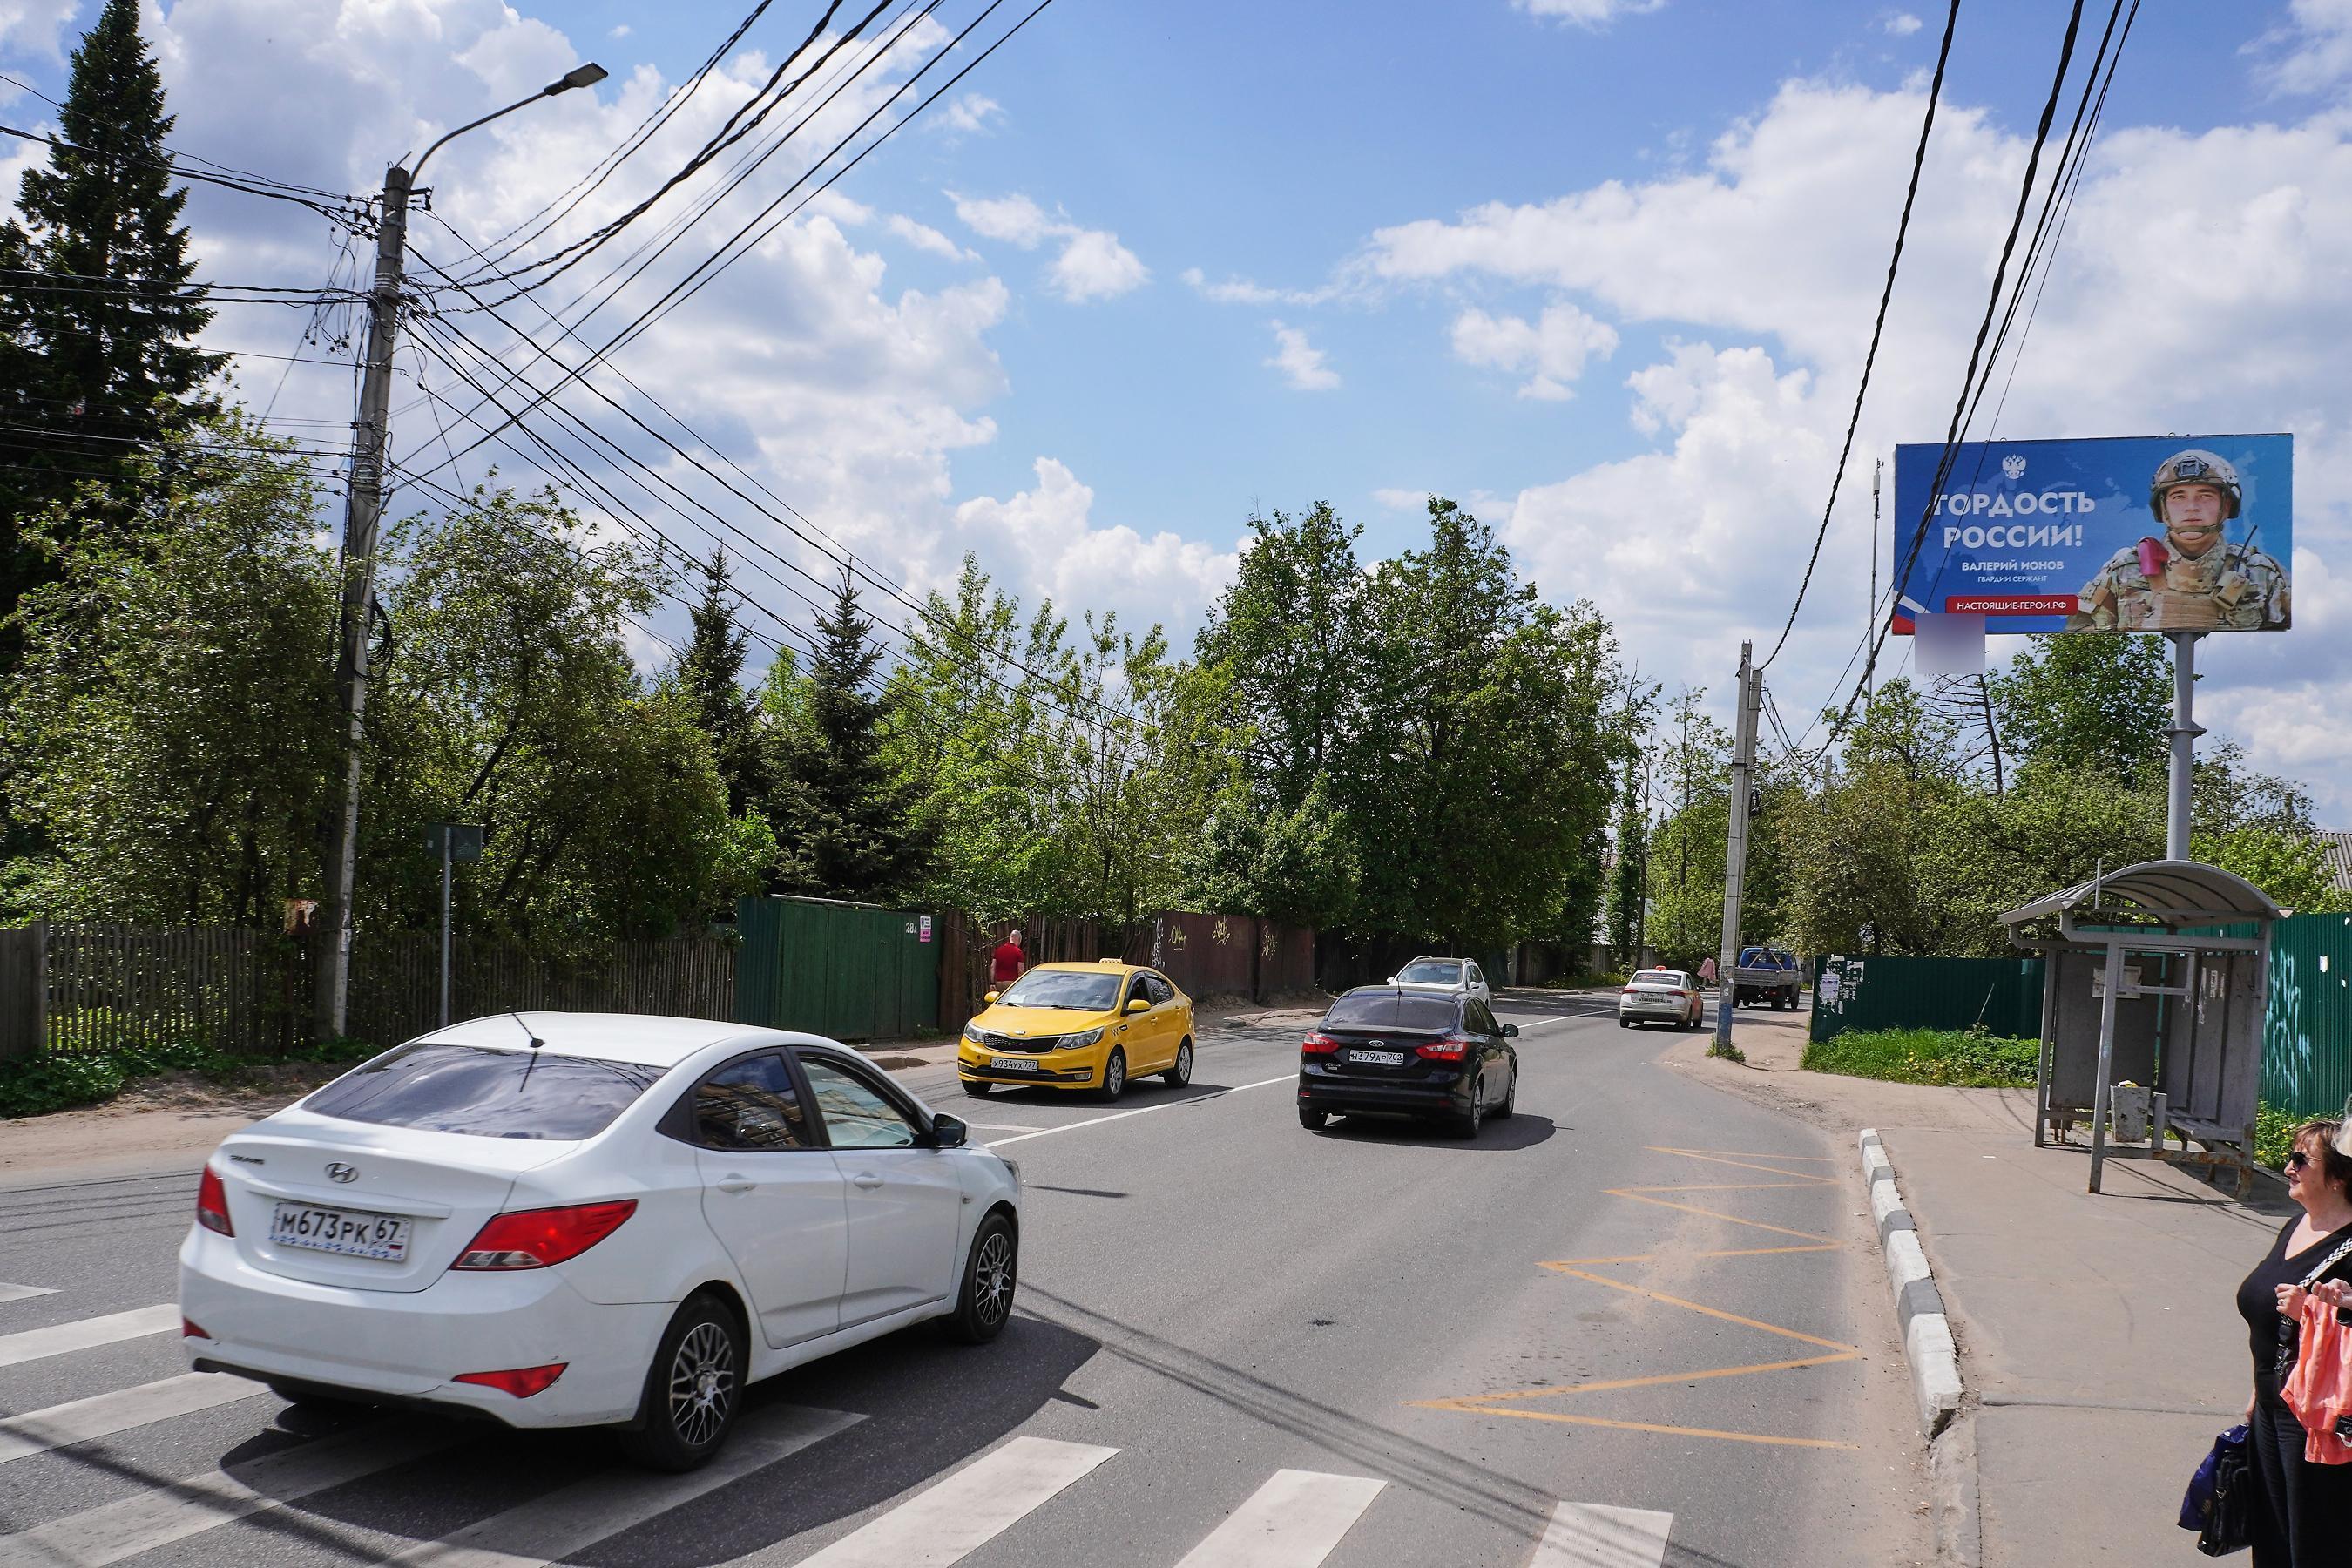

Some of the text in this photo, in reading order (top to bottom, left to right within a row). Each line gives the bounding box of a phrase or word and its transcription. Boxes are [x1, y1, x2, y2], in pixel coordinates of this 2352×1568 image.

[1933, 491, 2096, 518] ГОРДОСТЬ
[1943, 524, 2084, 549] РОССИИ!
[1961, 559, 2065, 571] ВАЛЕРИЙ ИОНОВ
[1957, 601, 2067, 611] НАСТОЯЩИЕ-ГЕРОИ.РФ
